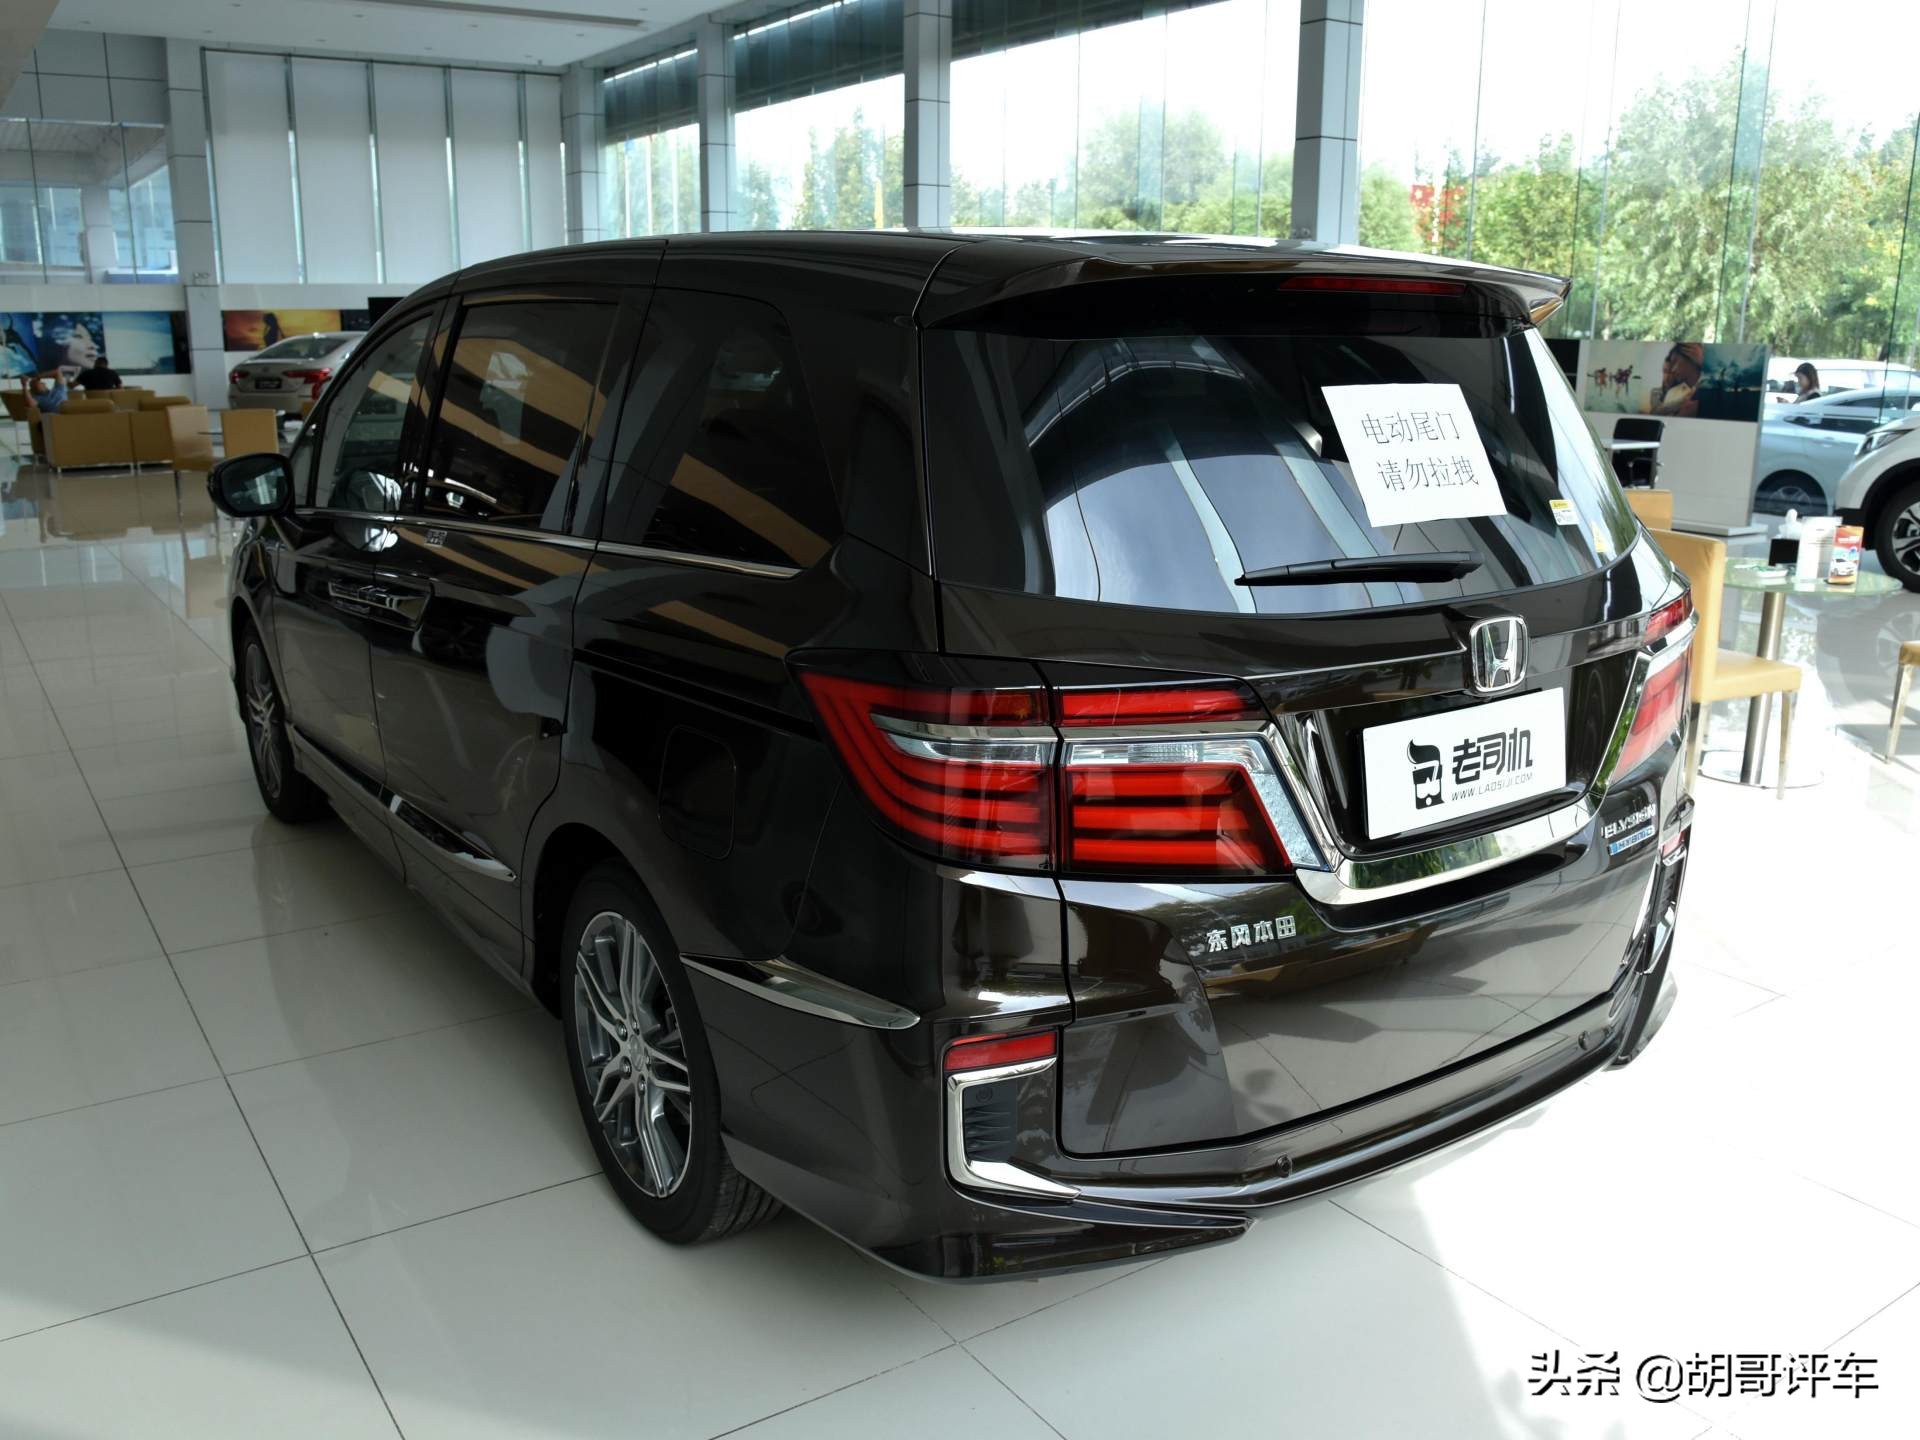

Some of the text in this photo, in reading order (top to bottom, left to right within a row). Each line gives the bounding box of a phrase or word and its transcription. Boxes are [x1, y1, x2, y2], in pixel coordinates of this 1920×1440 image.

[1361, 411, 1461, 444] 电动尾门
[1376, 455, 1480, 492] 请勿拉拽
[1452, 727, 1533, 786] 老司机
[1451, 772, 1533, 801] WWW.LAOSIJI.COM
[1206, 915, 1296, 953] 东风本田
